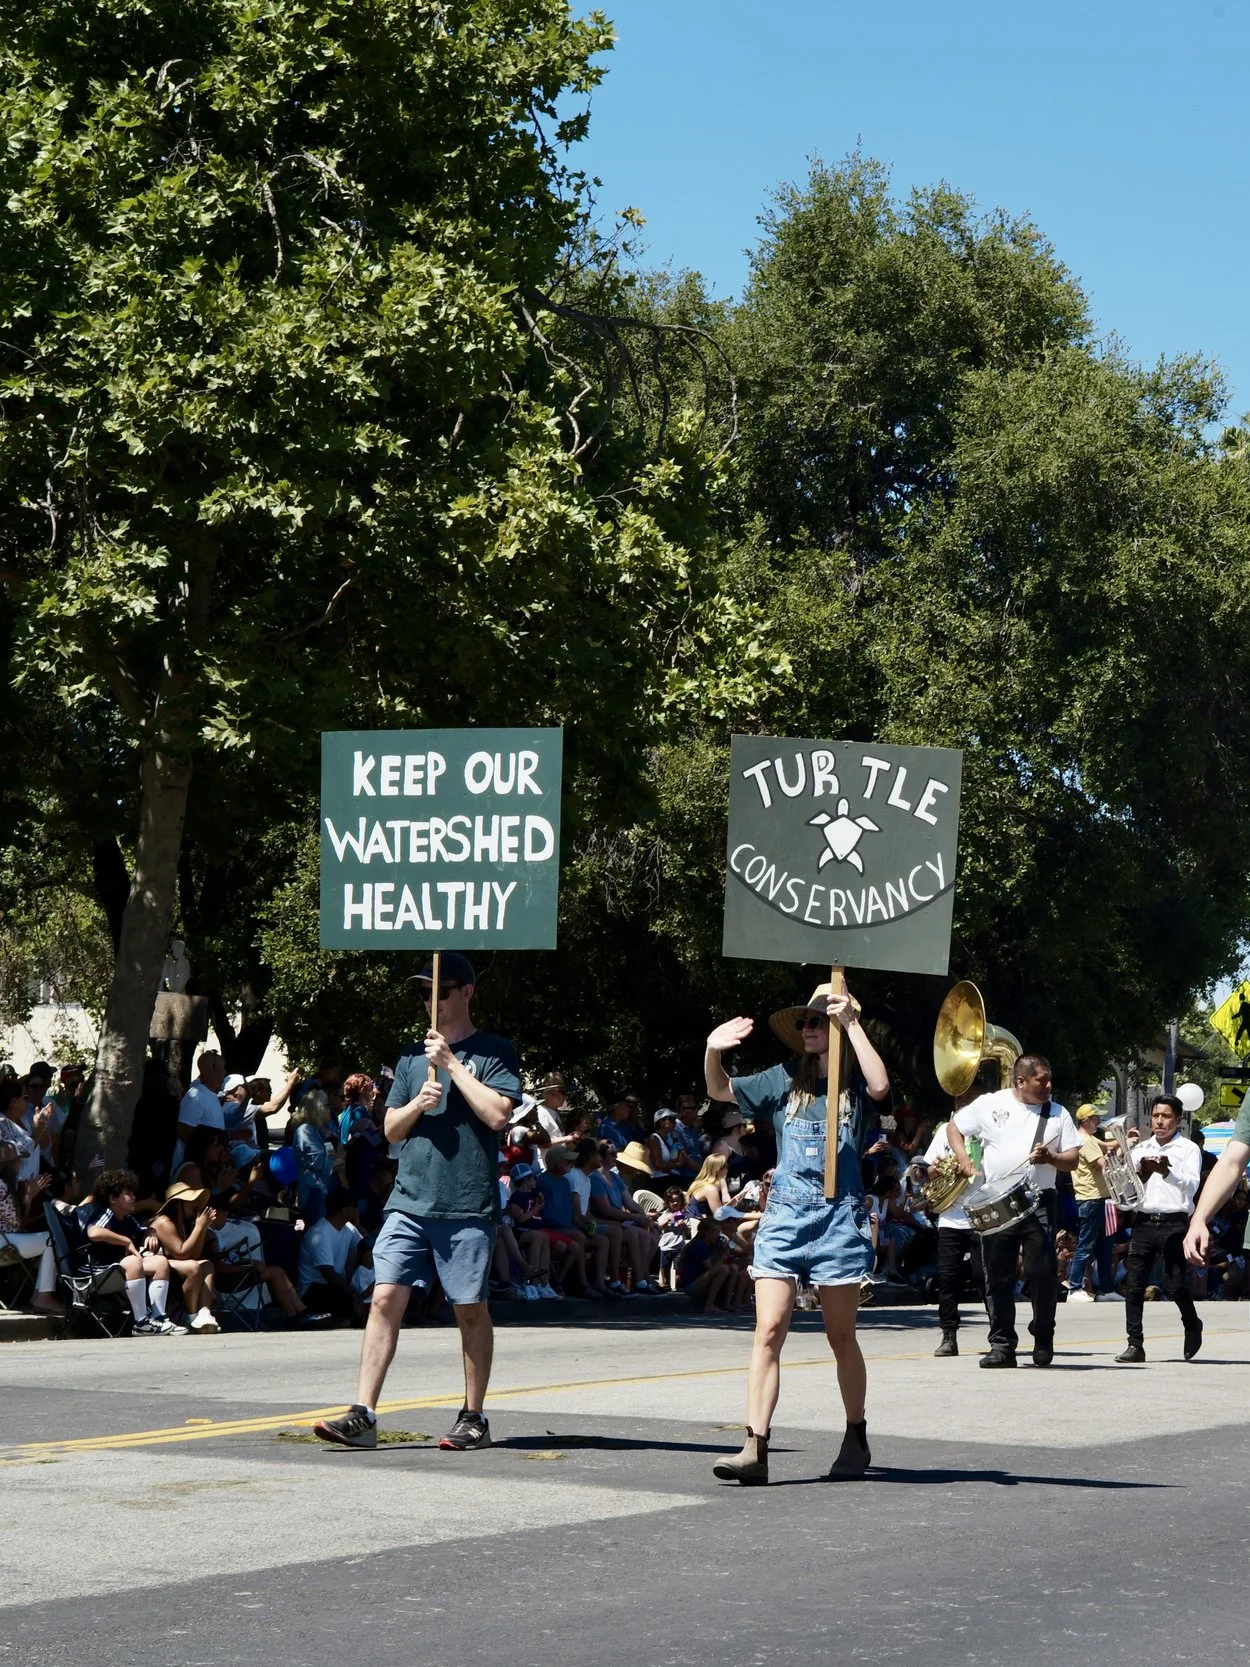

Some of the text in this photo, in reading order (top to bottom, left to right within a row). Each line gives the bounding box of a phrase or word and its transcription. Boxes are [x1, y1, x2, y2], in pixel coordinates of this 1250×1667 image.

[353, 750, 543, 796] KEEP OUR
[324, 815, 554, 864] WATERSHED
[343, 882, 517, 930] HEALTHY
[730, 843, 945, 926] CONSERVANCY
